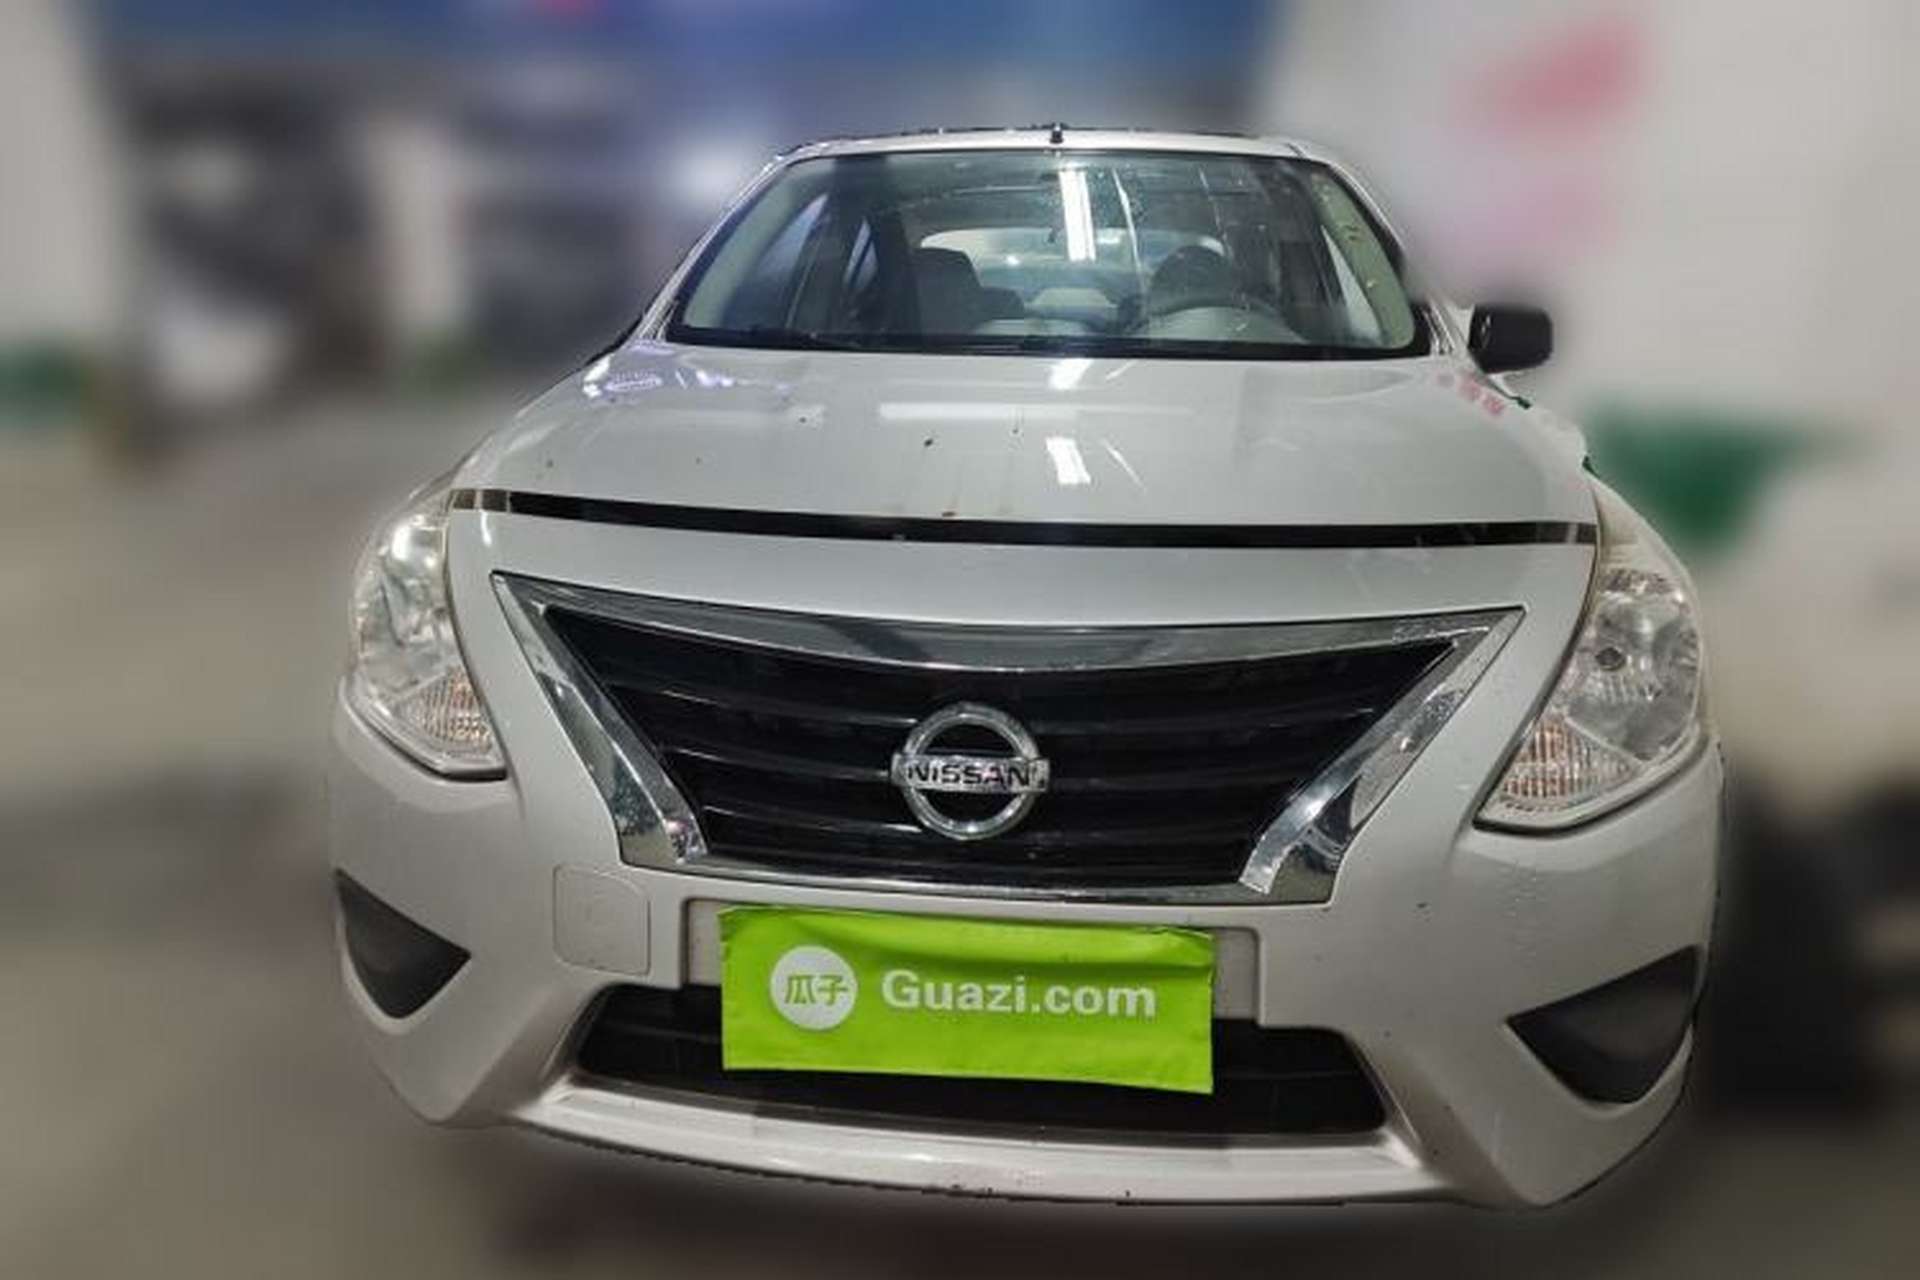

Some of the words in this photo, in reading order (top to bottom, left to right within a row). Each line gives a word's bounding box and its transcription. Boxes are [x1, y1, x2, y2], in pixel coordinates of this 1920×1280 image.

[907, 763, 1030, 788] NISSAN
[785, 974, 848, 1006] 瓜子
[882, 969, 1156, 1017] Guazi.com
